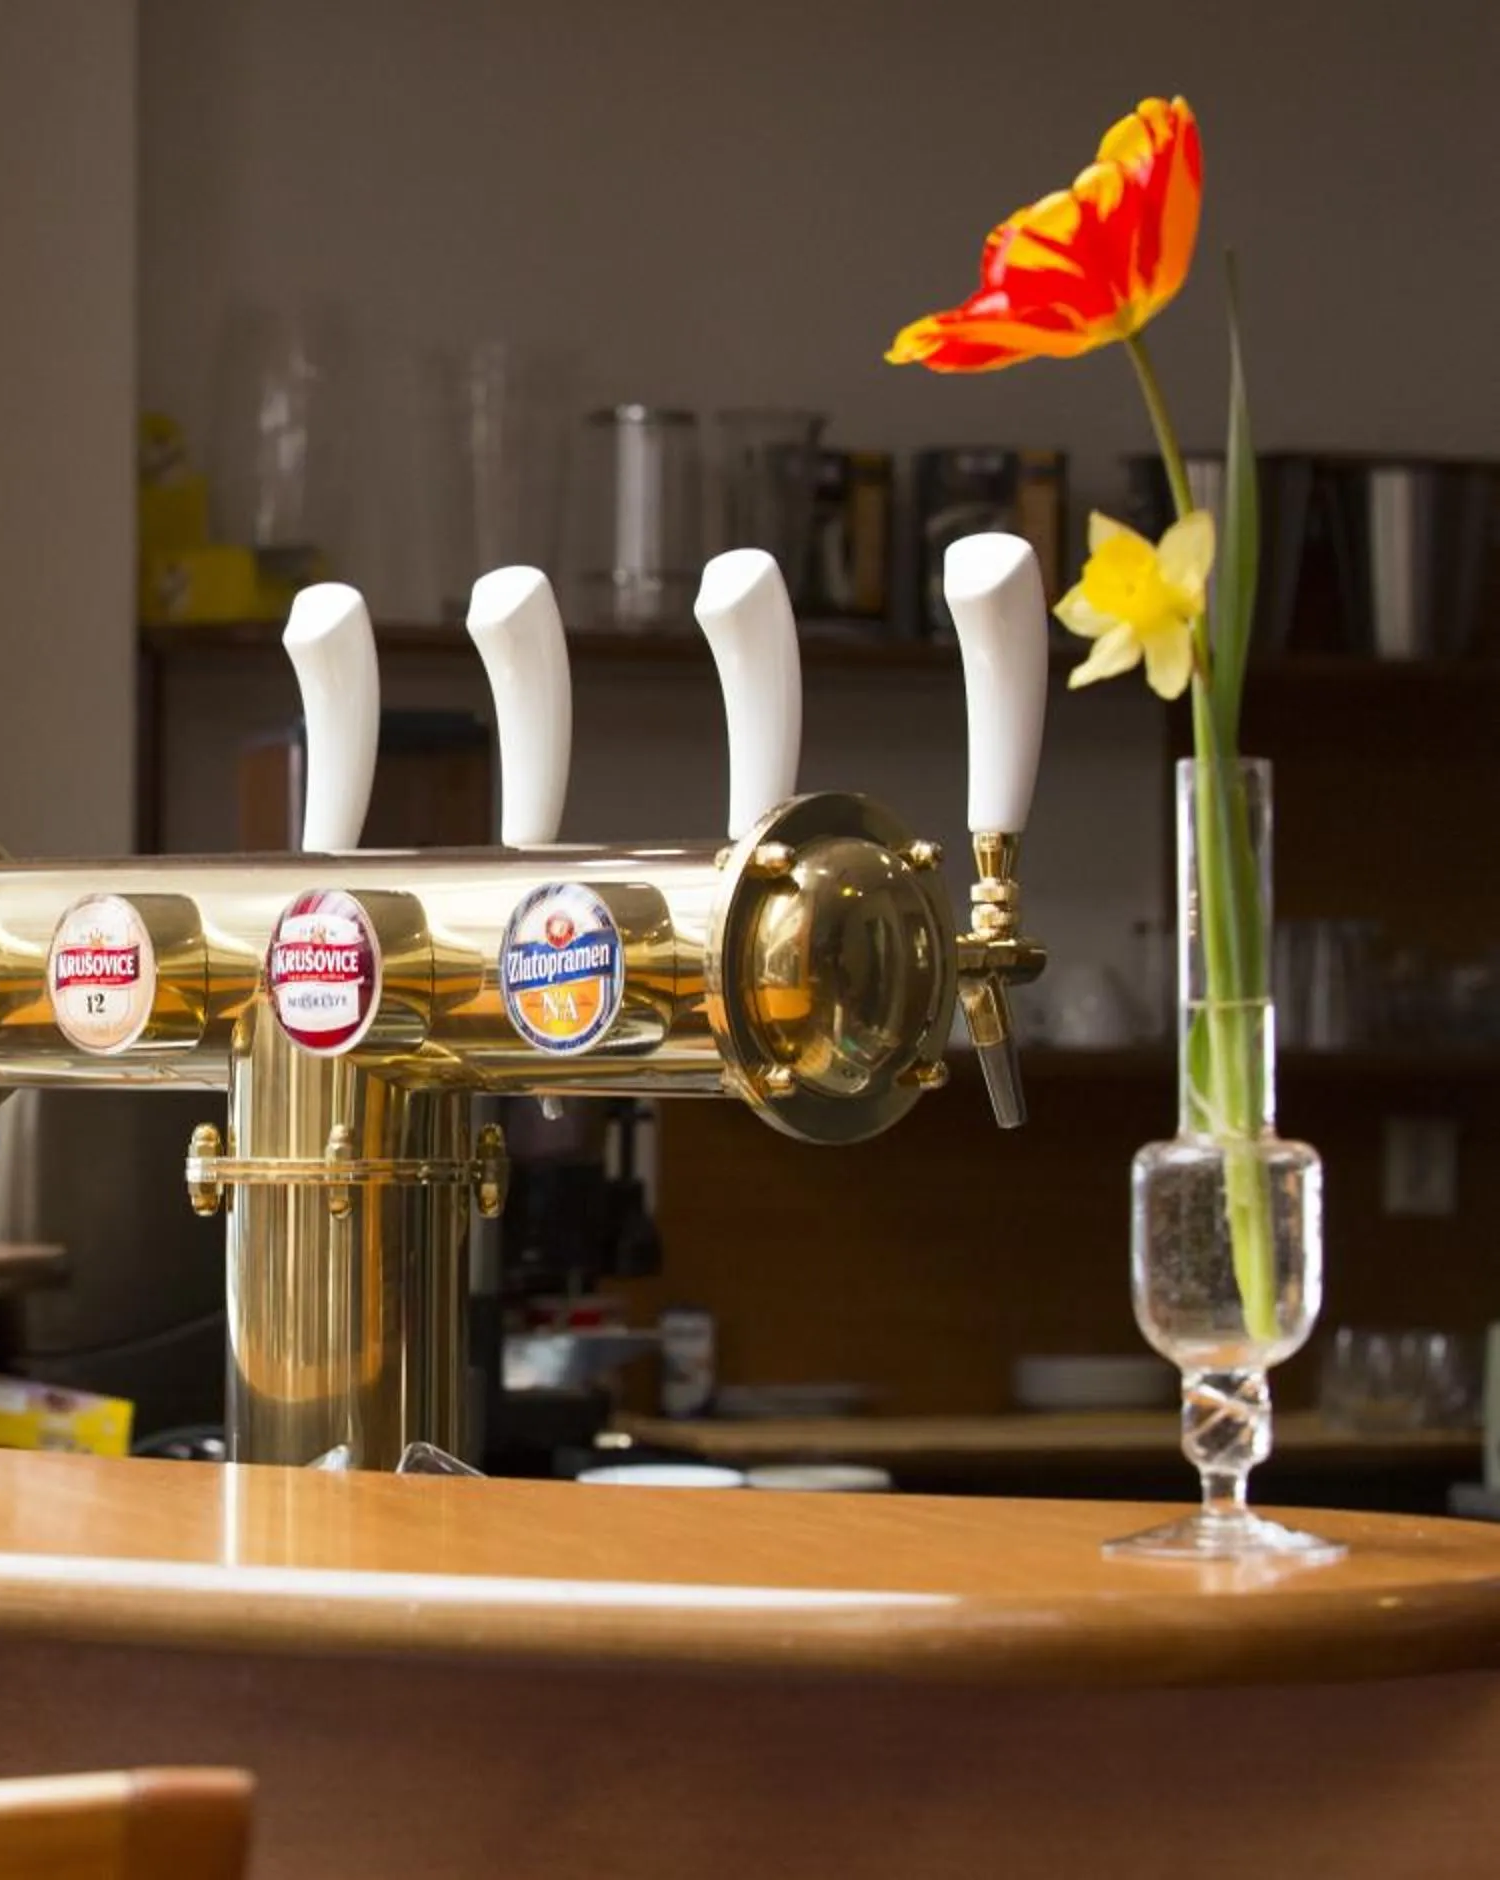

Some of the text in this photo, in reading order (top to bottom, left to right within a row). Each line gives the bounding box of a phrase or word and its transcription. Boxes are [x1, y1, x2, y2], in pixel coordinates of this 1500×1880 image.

[58, 952, 135, 978] KRUŠOVICE
[275, 947, 359, 973] KRUŠOVICE
[86, 993, 106, 1014] 12
